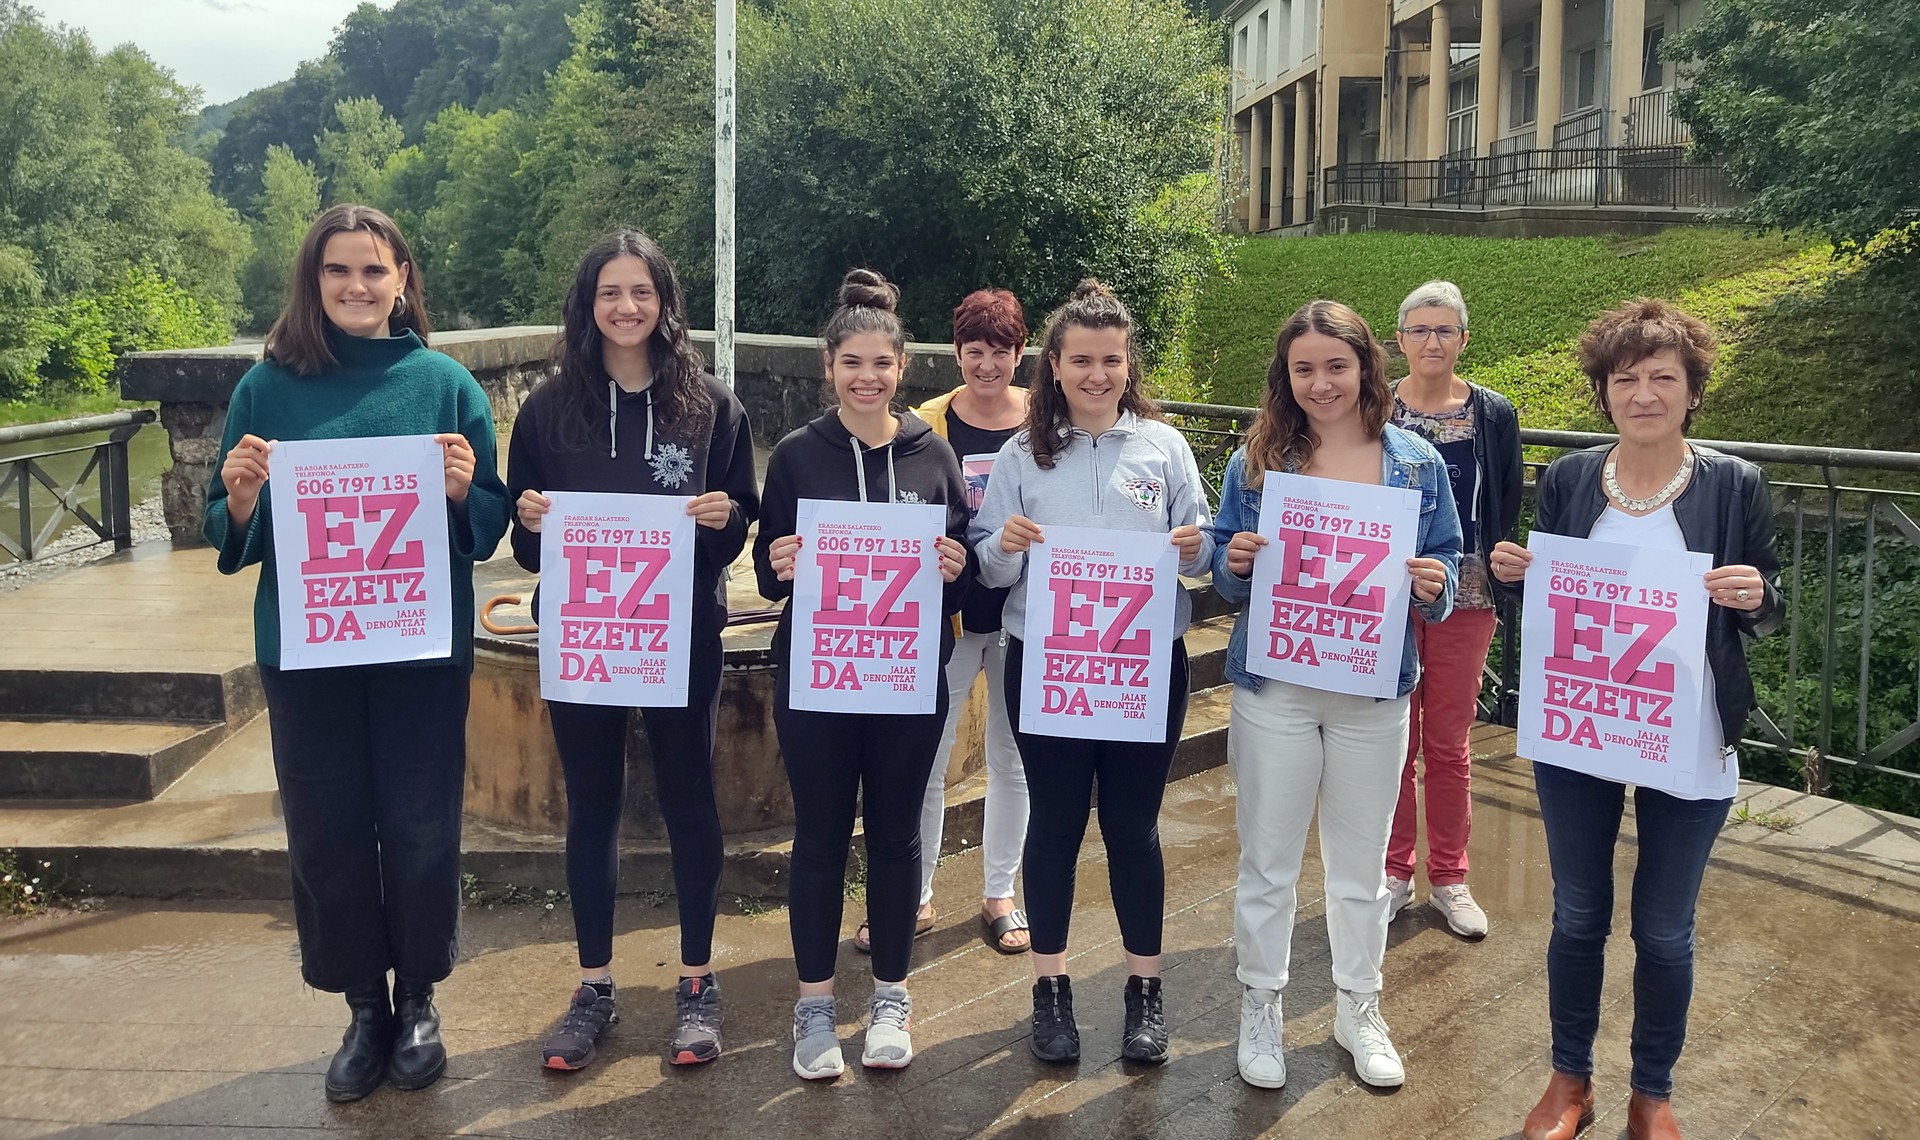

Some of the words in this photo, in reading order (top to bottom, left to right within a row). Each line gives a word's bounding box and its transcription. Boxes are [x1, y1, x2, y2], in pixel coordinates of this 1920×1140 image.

[297, 479, 334, 495] 606
[338, 476, 376, 493] 797
[382, 474, 418, 491] 135
[1283, 503, 1319, 512] TELEFONOA
[1284, 497, 1313, 506] ERASOAK
[1314, 501, 1350, 511] SALATZEKO
[297, 493, 425, 575] EZ
[1281, 511, 1315, 528] 606
[1320, 516, 1353, 533] 797
[1358, 521, 1392, 539] 135
[564, 528, 597, 543] 606
[601, 530, 634, 544] 797
[639, 531, 671, 545] 135
[817, 537, 849, 551] 606
[854, 538, 885, 553] 797
[890, 539, 921, 554] 135
[1050, 561, 1082, 576] 606
[1086, 563, 1118, 579] 797
[1123, 566, 1154, 581] 135
[1272, 527, 1390, 613] EZ
[1551, 560, 1584, 570] ERASOAK
[1585, 565, 1627, 576] SALATZEKO
[1551, 567, 1591, 577] TELEFONOA
[303, 572, 426, 609] EZETZ
[561, 546, 671, 620] EZ
[813, 553, 921, 628] EZ
[1550, 575, 1588, 595] 606
[1593, 582, 1632, 601] 797
[1638, 588, 1678, 608] 135
[397, 609, 426, 619] JAIAK
[1044, 578, 1153, 656] EZ
[1269, 601, 1383, 644] EZETZ
[306, 611, 366, 643] DA
[366, 619, 426, 630] DENONTZAT
[401, 628, 426, 637] DIRA
[560, 620, 668, 652] EZETZ
[812, 628, 918, 659] EZETZ
[1544, 593, 1677, 693] EZ
[1267, 631, 1320, 667] DA
[1350, 647, 1378, 658] JAIAK
[560, 652, 611, 682] DA
[640, 659, 666, 667] JAIAK
[1321, 651, 1377, 666] DENONTZAT
[612, 667, 666, 675] DENONTZAT
[811, 660, 863, 690] DA
[863, 674, 916, 683] DENONTZAT
[890, 666, 916, 674] JAIAK
[1043, 653, 1149, 687] EZETZ
[1352, 665, 1376, 675] DIRA
[642, 676, 665, 684] DIRA
[893, 683, 915, 691] DIRA
[1041, 685, 1093, 716] DA
[1094, 700, 1146, 710] DENONTZAT
[1121, 693, 1146, 702] JAIAK
[1543, 674, 1673, 728] EZETZ
[1123, 711, 1145, 719] DIRA
[1541, 708, 1603, 750] DA
[1637, 730, 1669, 744] JAIAK
[1604, 733, 1669, 753] DENONTZAT
[1640, 750, 1667, 763] DIRA
